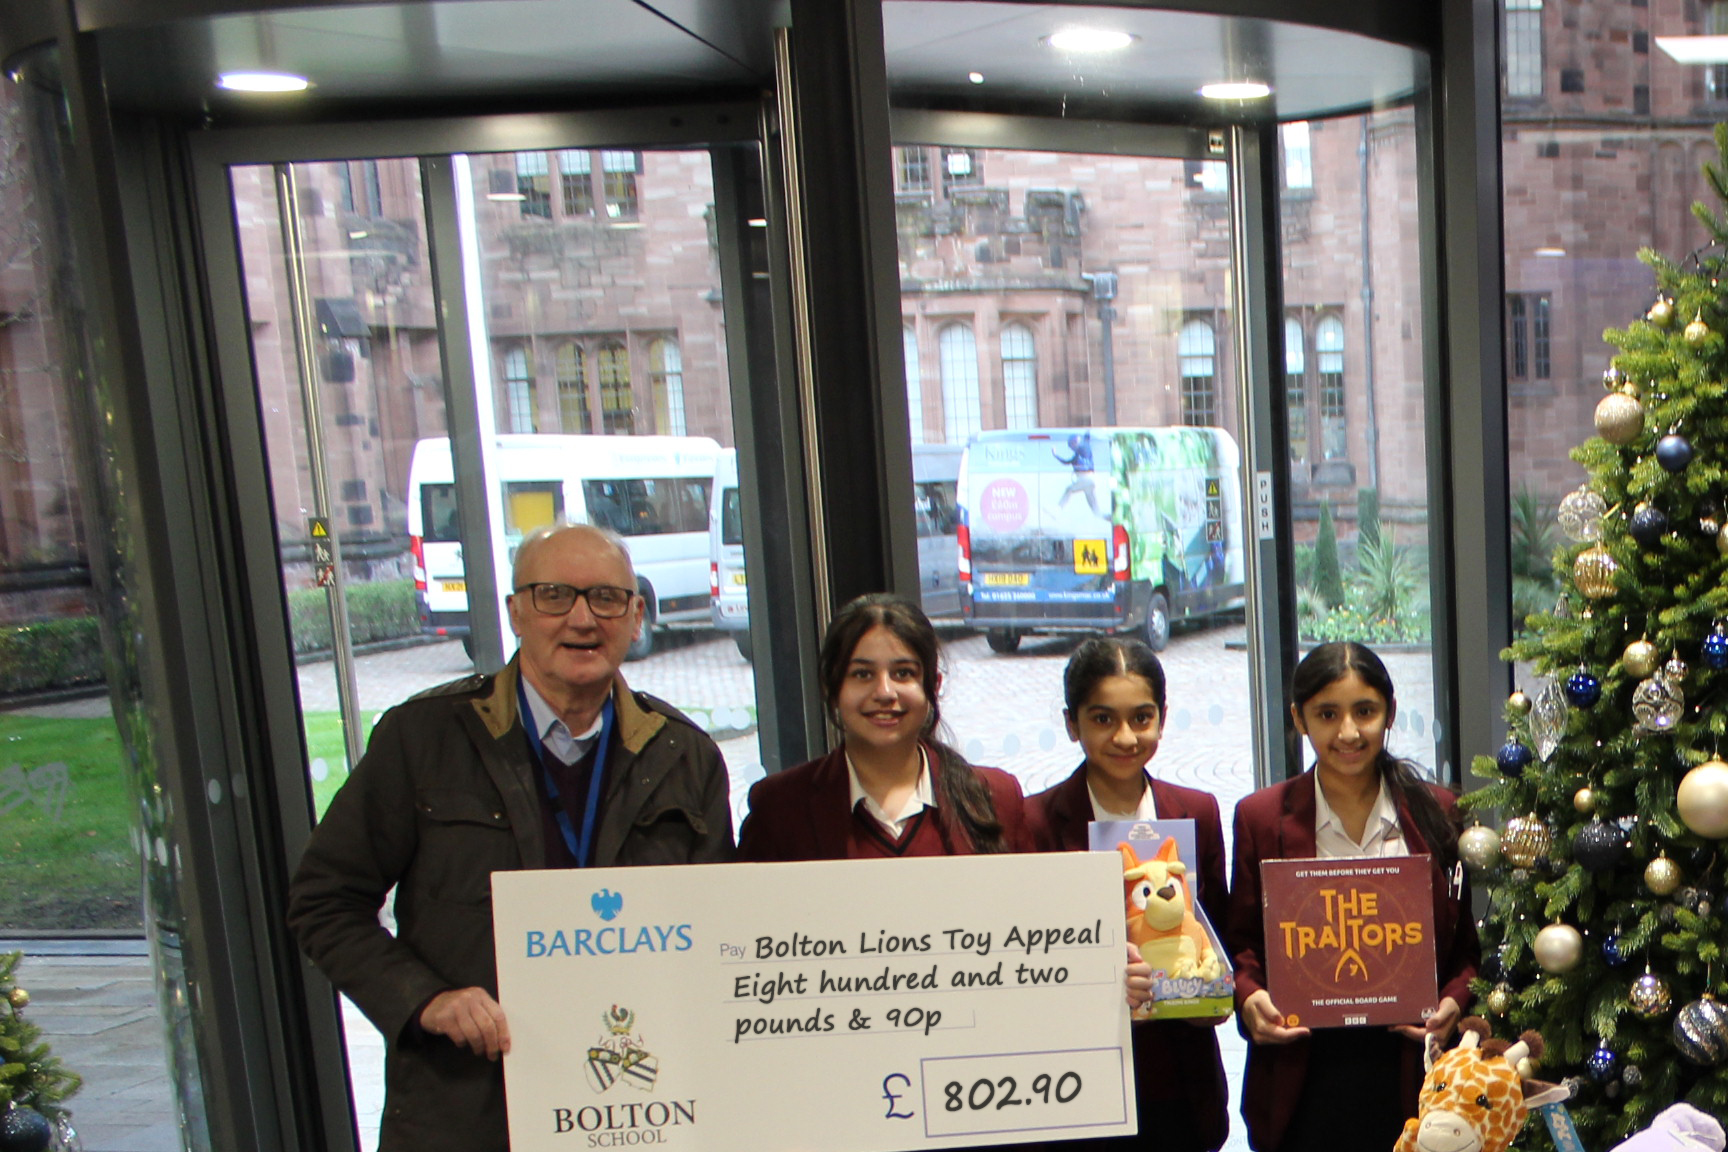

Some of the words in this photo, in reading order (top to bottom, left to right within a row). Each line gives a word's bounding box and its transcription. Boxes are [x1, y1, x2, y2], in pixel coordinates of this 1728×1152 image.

[992, 487, 1017, 498] NEW
[1260, 480, 1269, 531] PUSH
[1320, 888, 1378, 923] THE
[525, 923, 693, 958] BARCLAYS
[719, 942, 746, 959] Pay
[754, 934, 847, 960] Bolton
[860, 931, 931, 955] Lions
[943, 927, 992, 959] Toy
[1004, 920, 1102, 954] Appeal
[1280, 918, 1423, 960] TRAITORS
[733, 970, 807, 1004] Eight
[820, 965, 939, 993] hundred
[951, 963, 1003, 988] and
[1015, 961, 1069, 985] two
[1325, 998, 1353, 1006] OFFICIAL
[735, 1008, 835, 1043] pounds
[849, 1010, 872, 1031] &
[886, 1006, 942, 1037] 90p
[882, 1073, 915, 1119] £
[944, 1071, 1083, 1112] 802.90
[552, 1099, 697, 1134] BOLTON
[587, 1127, 667, 1149] SCHOOL
